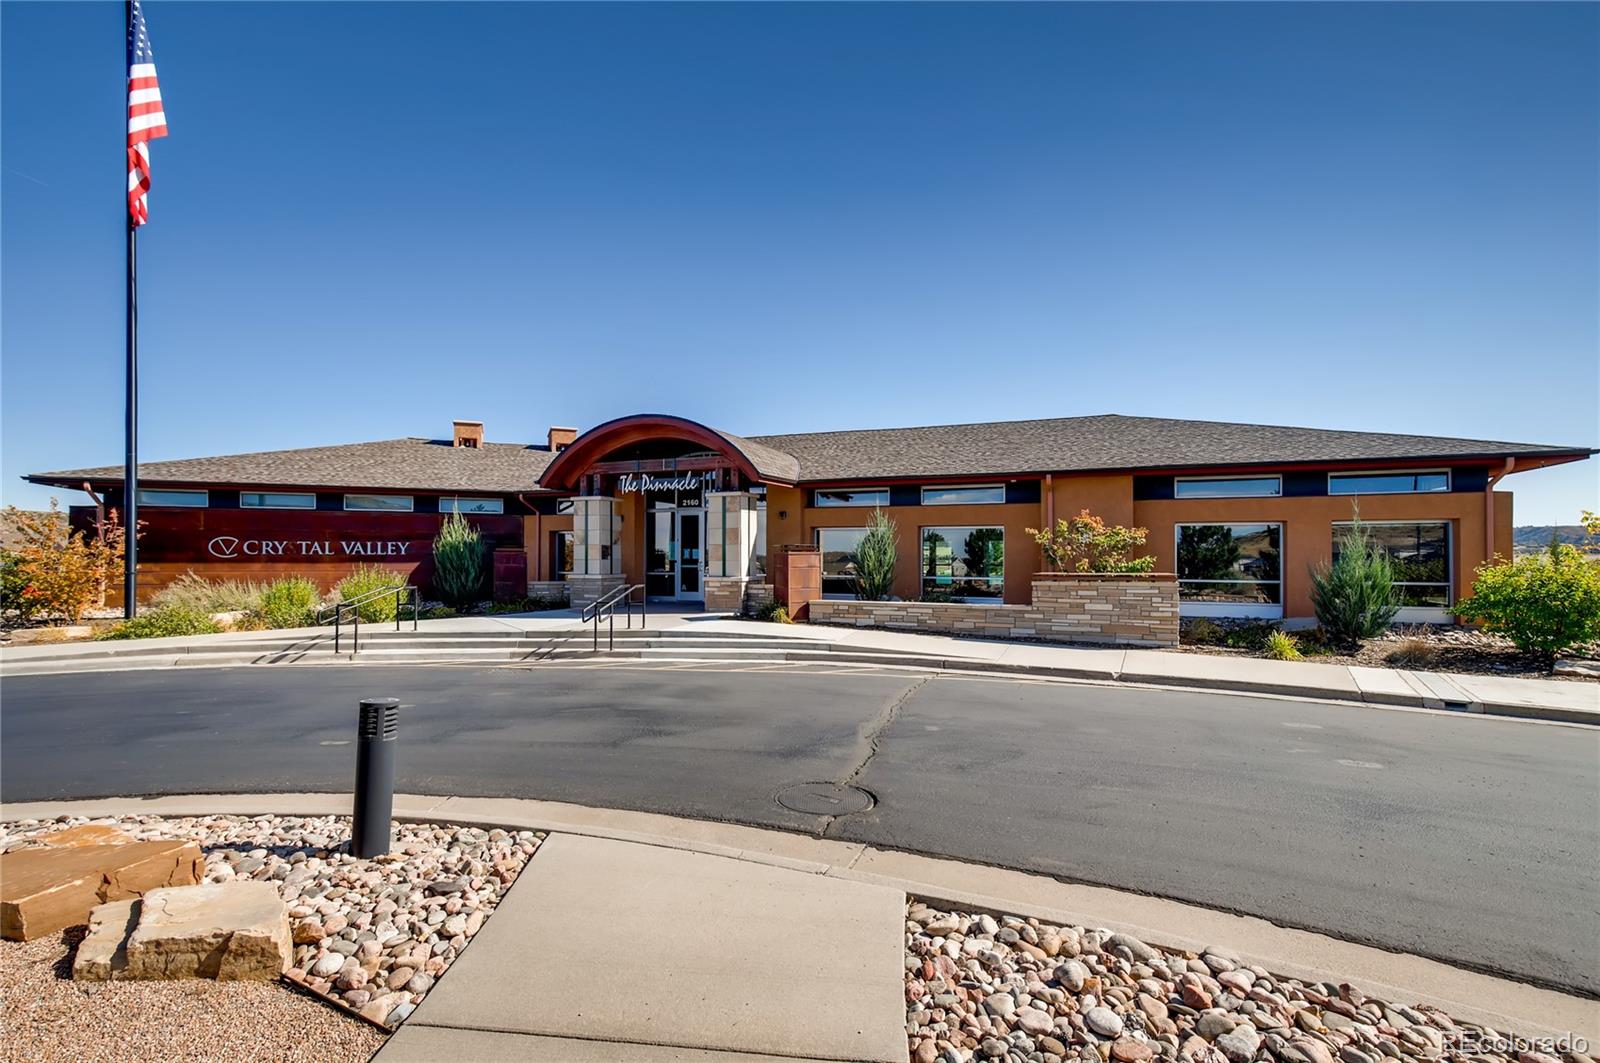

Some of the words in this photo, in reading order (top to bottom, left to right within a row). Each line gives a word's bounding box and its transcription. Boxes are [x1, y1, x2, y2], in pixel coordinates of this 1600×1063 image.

[620, 473, 638, 495] The
[641, 470, 698, 495] Pinnacle
[243, 540, 335, 555] CRYTAL
[340, 541, 410, 555] VALLEY
